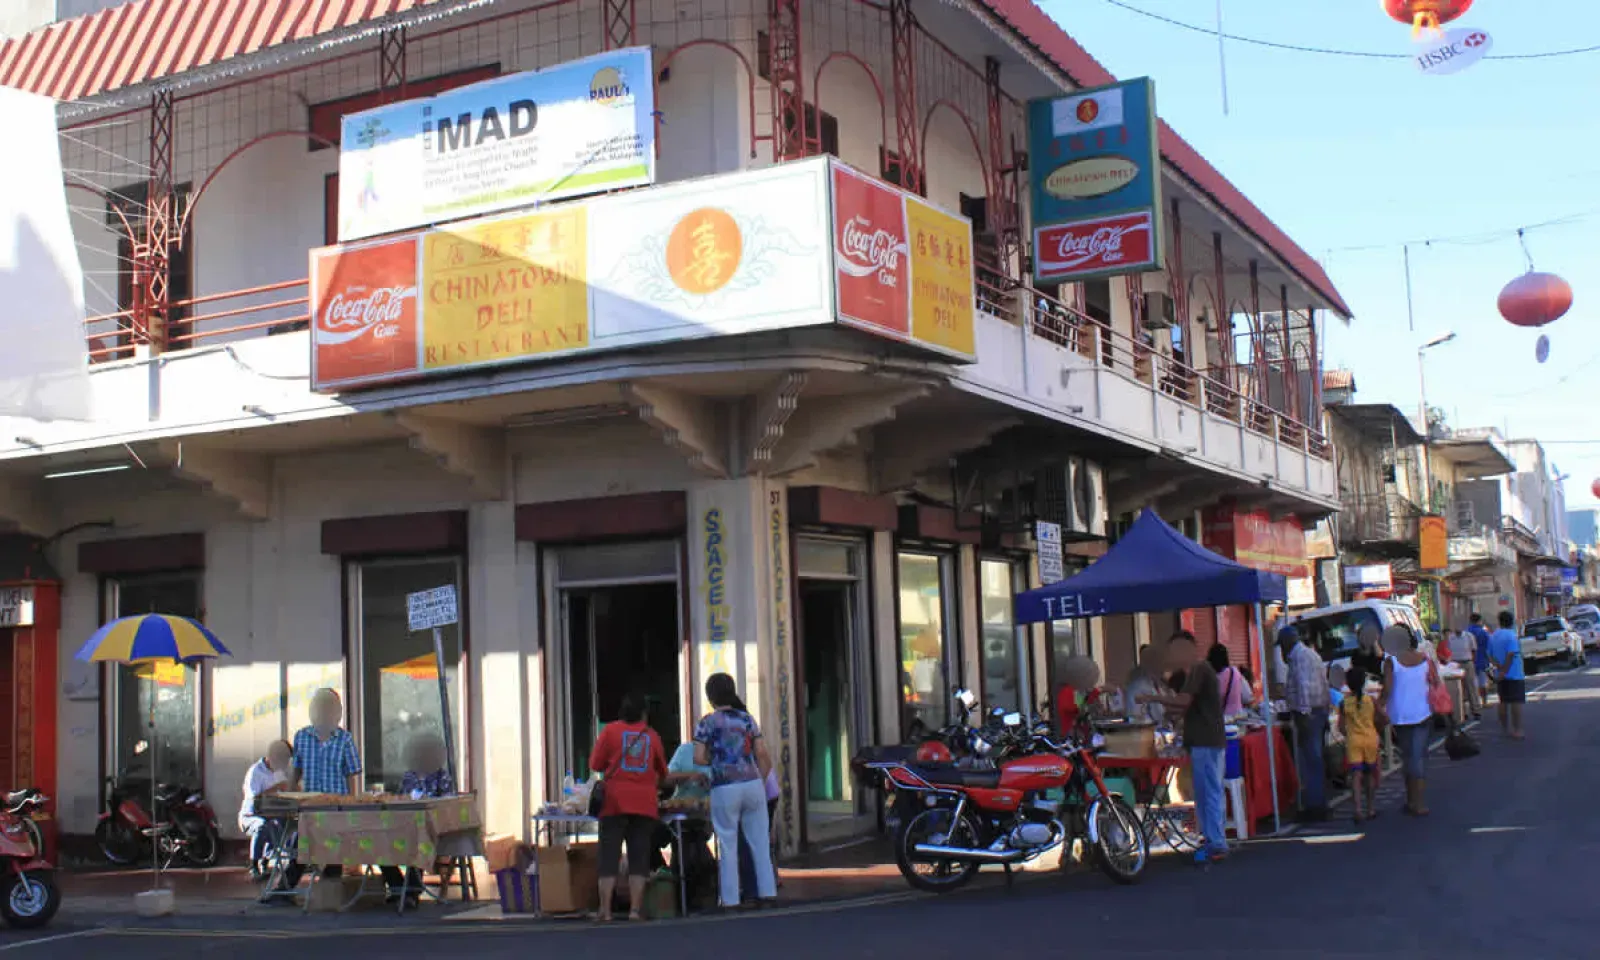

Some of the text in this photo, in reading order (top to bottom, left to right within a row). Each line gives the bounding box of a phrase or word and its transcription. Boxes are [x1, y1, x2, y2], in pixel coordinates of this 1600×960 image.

[1417, 42, 1464, 71] HSBC
[437, 99, 539, 154] MAD
[842, 215, 898, 271] Coca-Cola
[1057, 226, 1125, 258] Coca-Cola
[429, 259, 579, 304] CHINATOWN
[324, 286, 403, 328] Coca-Cola
[477, 298, 533, 330] DELI
[705, 509, 724, 605] SPACE
